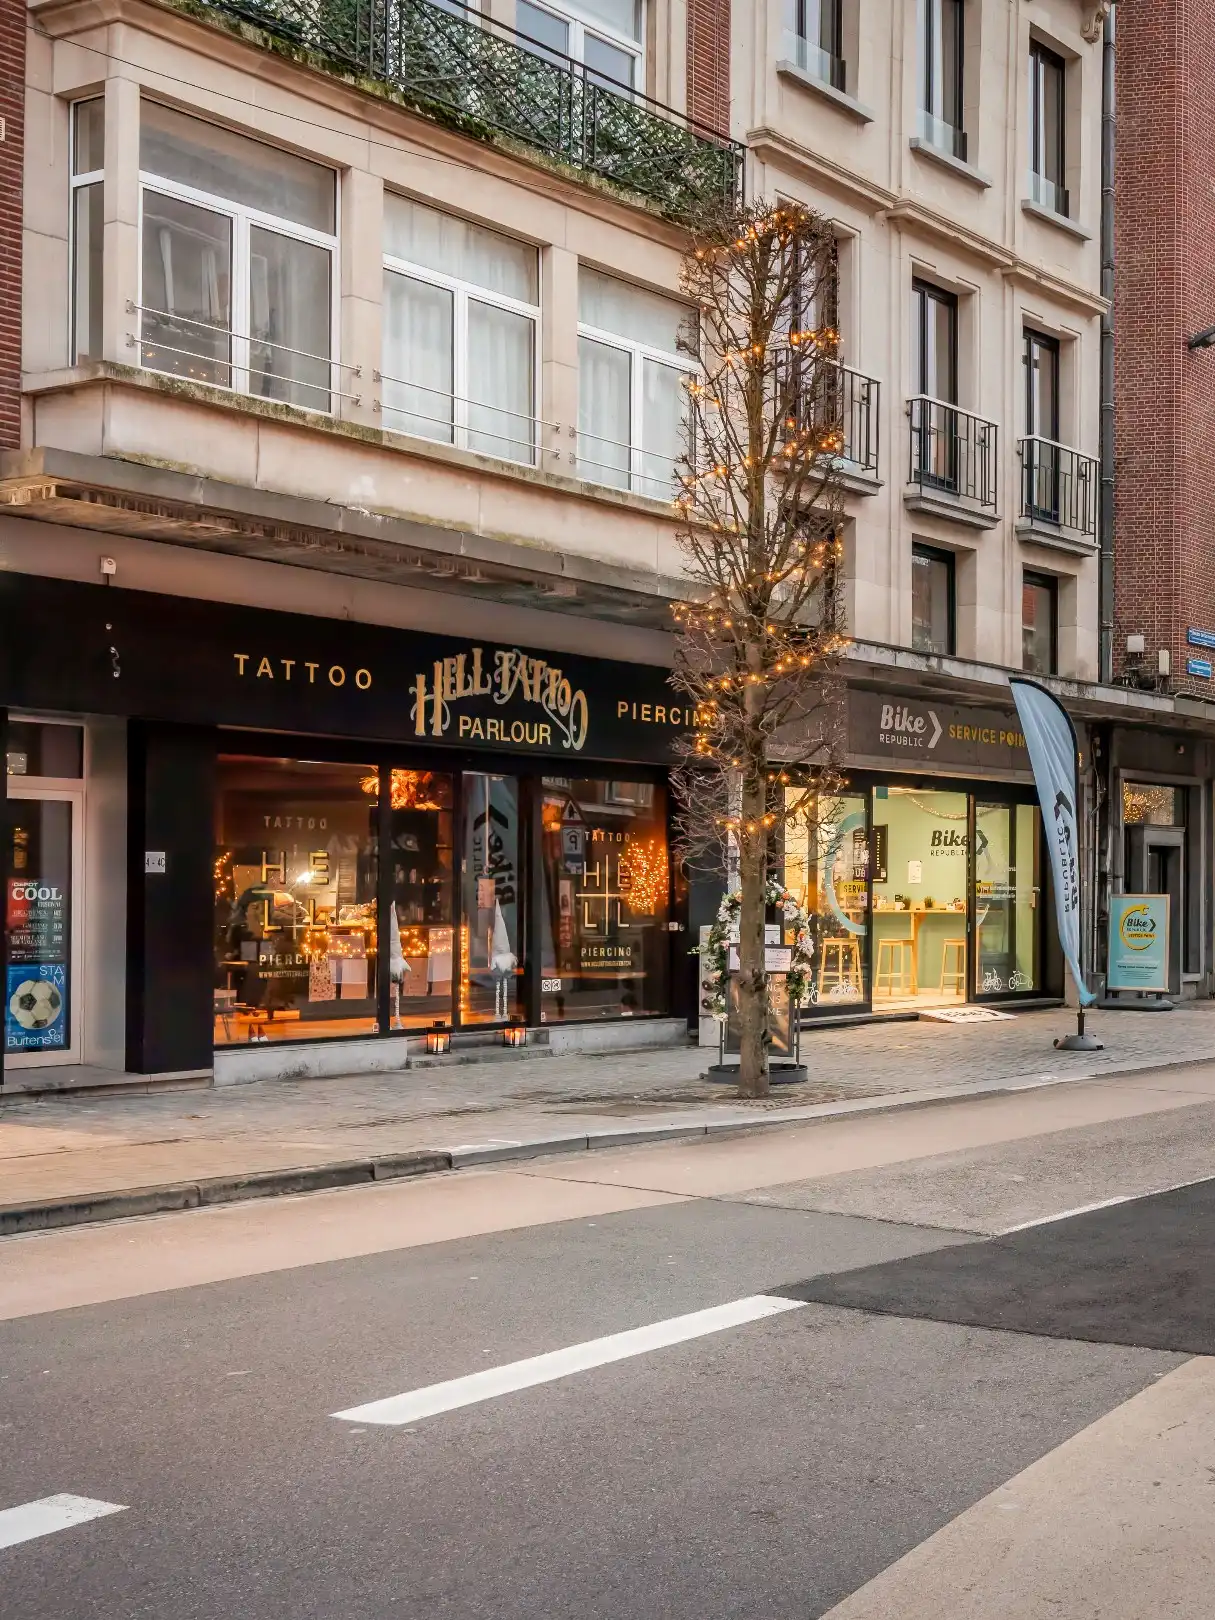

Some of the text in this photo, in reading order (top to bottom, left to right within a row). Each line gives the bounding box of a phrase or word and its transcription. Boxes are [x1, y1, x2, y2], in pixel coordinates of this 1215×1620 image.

[233, 653, 372, 690] TATTOO
[408, 648, 588, 750] HELL TATTOO
[880, 704, 928, 734] Bike
[459, 715, 551, 746] PARLOUR
[949, 724, 1027, 748] SERVICE POIN
[879, 733, 923, 748] REPUBLIC
[264, 816, 328, 830] TATTOO
[585, 831, 630, 842] TATTOO
[930, 849, 968, 857] REPUBLI
[12, 887, 63, 901] COOL
[1127, 918, 1148, 927] Bike
[581, 947, 632, 957] PIERCING
[39, 965, 64, 976] STA
